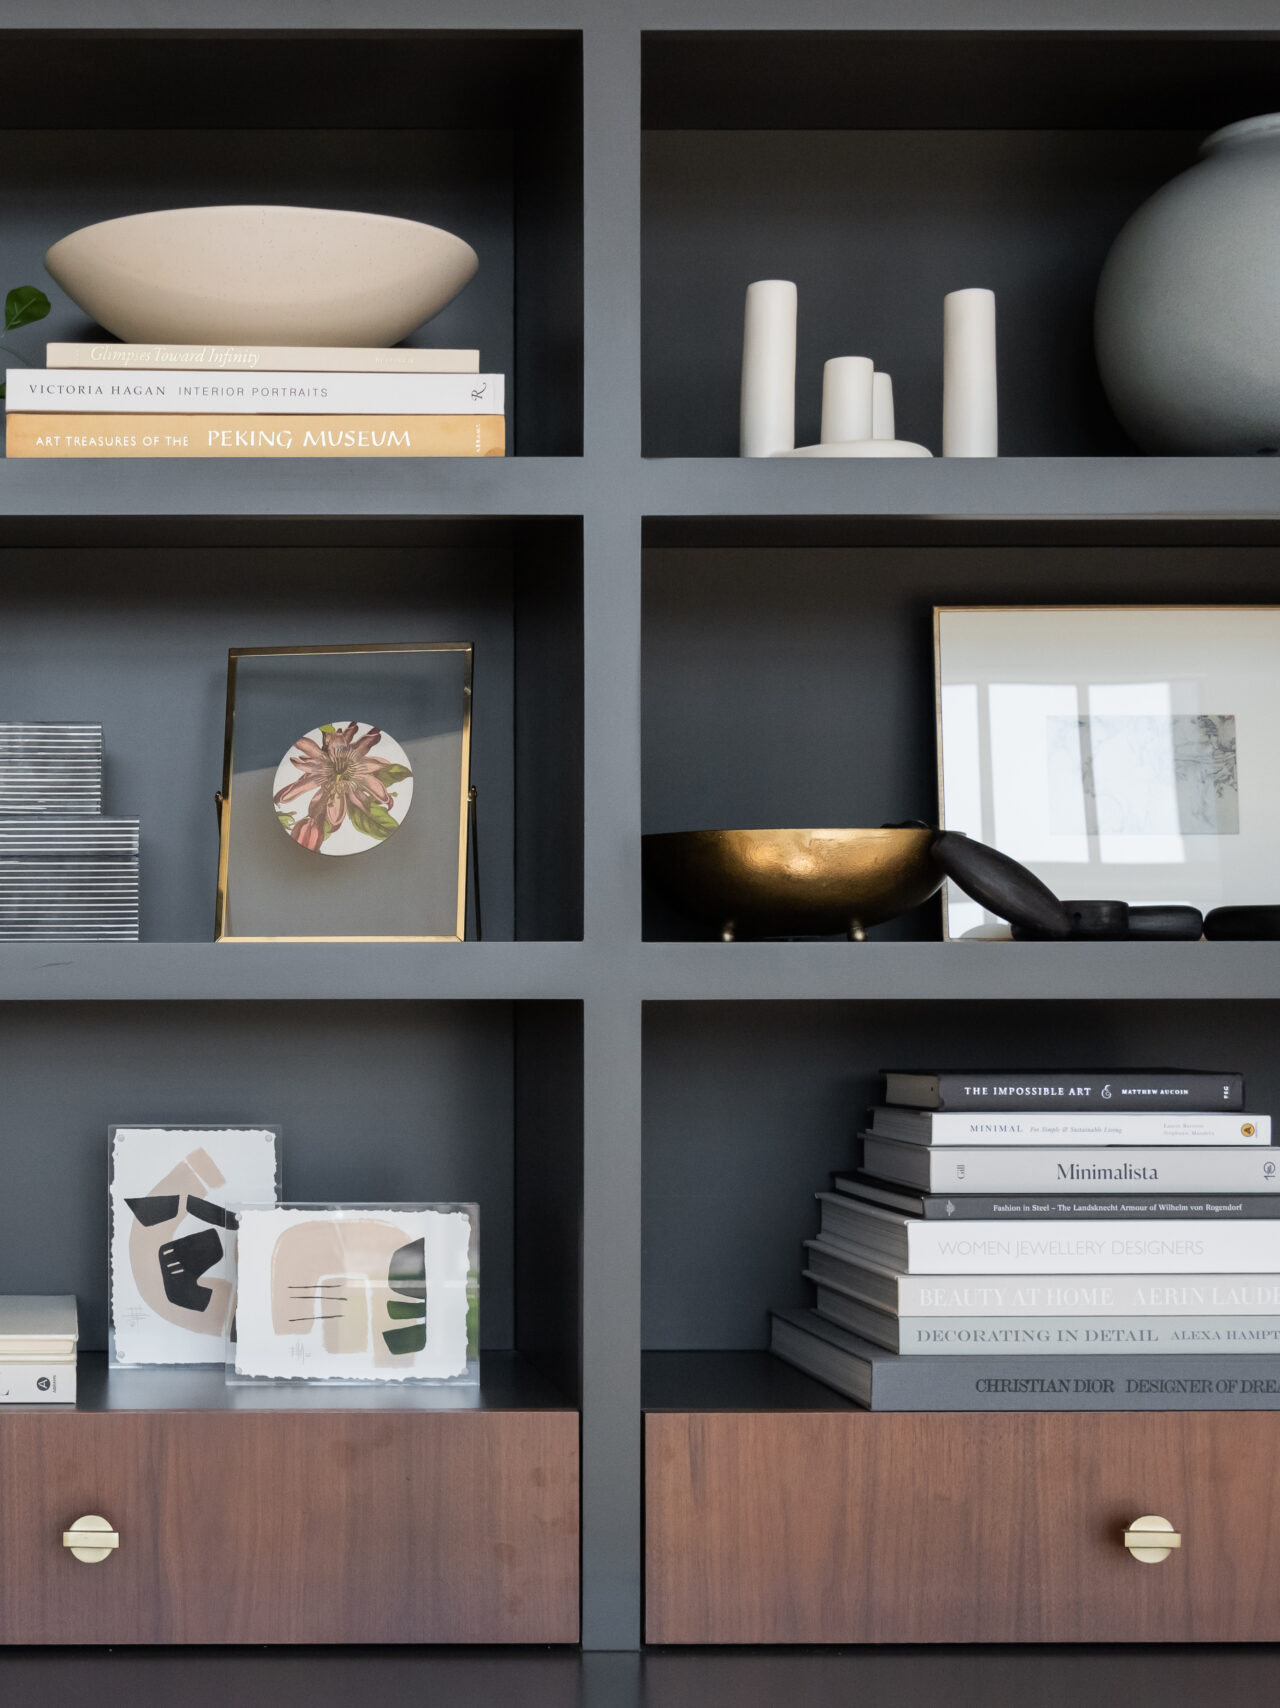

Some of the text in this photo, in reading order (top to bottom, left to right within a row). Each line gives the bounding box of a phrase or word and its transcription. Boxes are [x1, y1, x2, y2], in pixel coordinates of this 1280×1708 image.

[90, 346, 260, 368] Glimpses Toward Infinity
[29, 385, 328, 398] VICTORIA HAGAN INTERIOR PORTRAITS
[36, 436, 189, 446] ART TREASURES OF THE
[208, 430, 411, 448] PEKING MUSEUM
[964, 1087, 988, 1096] THE
[993, 1087, 1064, 1096] IMPOSSIBLE
[1068, 1087, 1091, 1096] ART
[970, 1125, 1023, 1133] MINIMAL
[1057, 1163, 1159, 1180] Minimalista
[993, 1204, 1020, 1212] Fashion
[1206, 1204, 1242, 1212] Rogendorf
[937, 1240, 1205, 1258] WOMEN JEWELLERY DESIGNERS
[920, 1288, 1008, 1306] BEAUTY
[1010, 1288, 1041, 1306] AT
[1047, 1288, 1113, 1306] HOME
[1134, 1287, 1208, 1305] AERIN
[916, 1330, 1050, 1342] DECORATING
[1058, 1330, 1078, 1342] IN
[1086, 1330, 1158, 1342] DETAIL
[1170, 1331, 1222, 1340] ALEXA
[975, 1379, 1280, 1393] CHRISTIAN DIOR DESIGNER OF DRE
